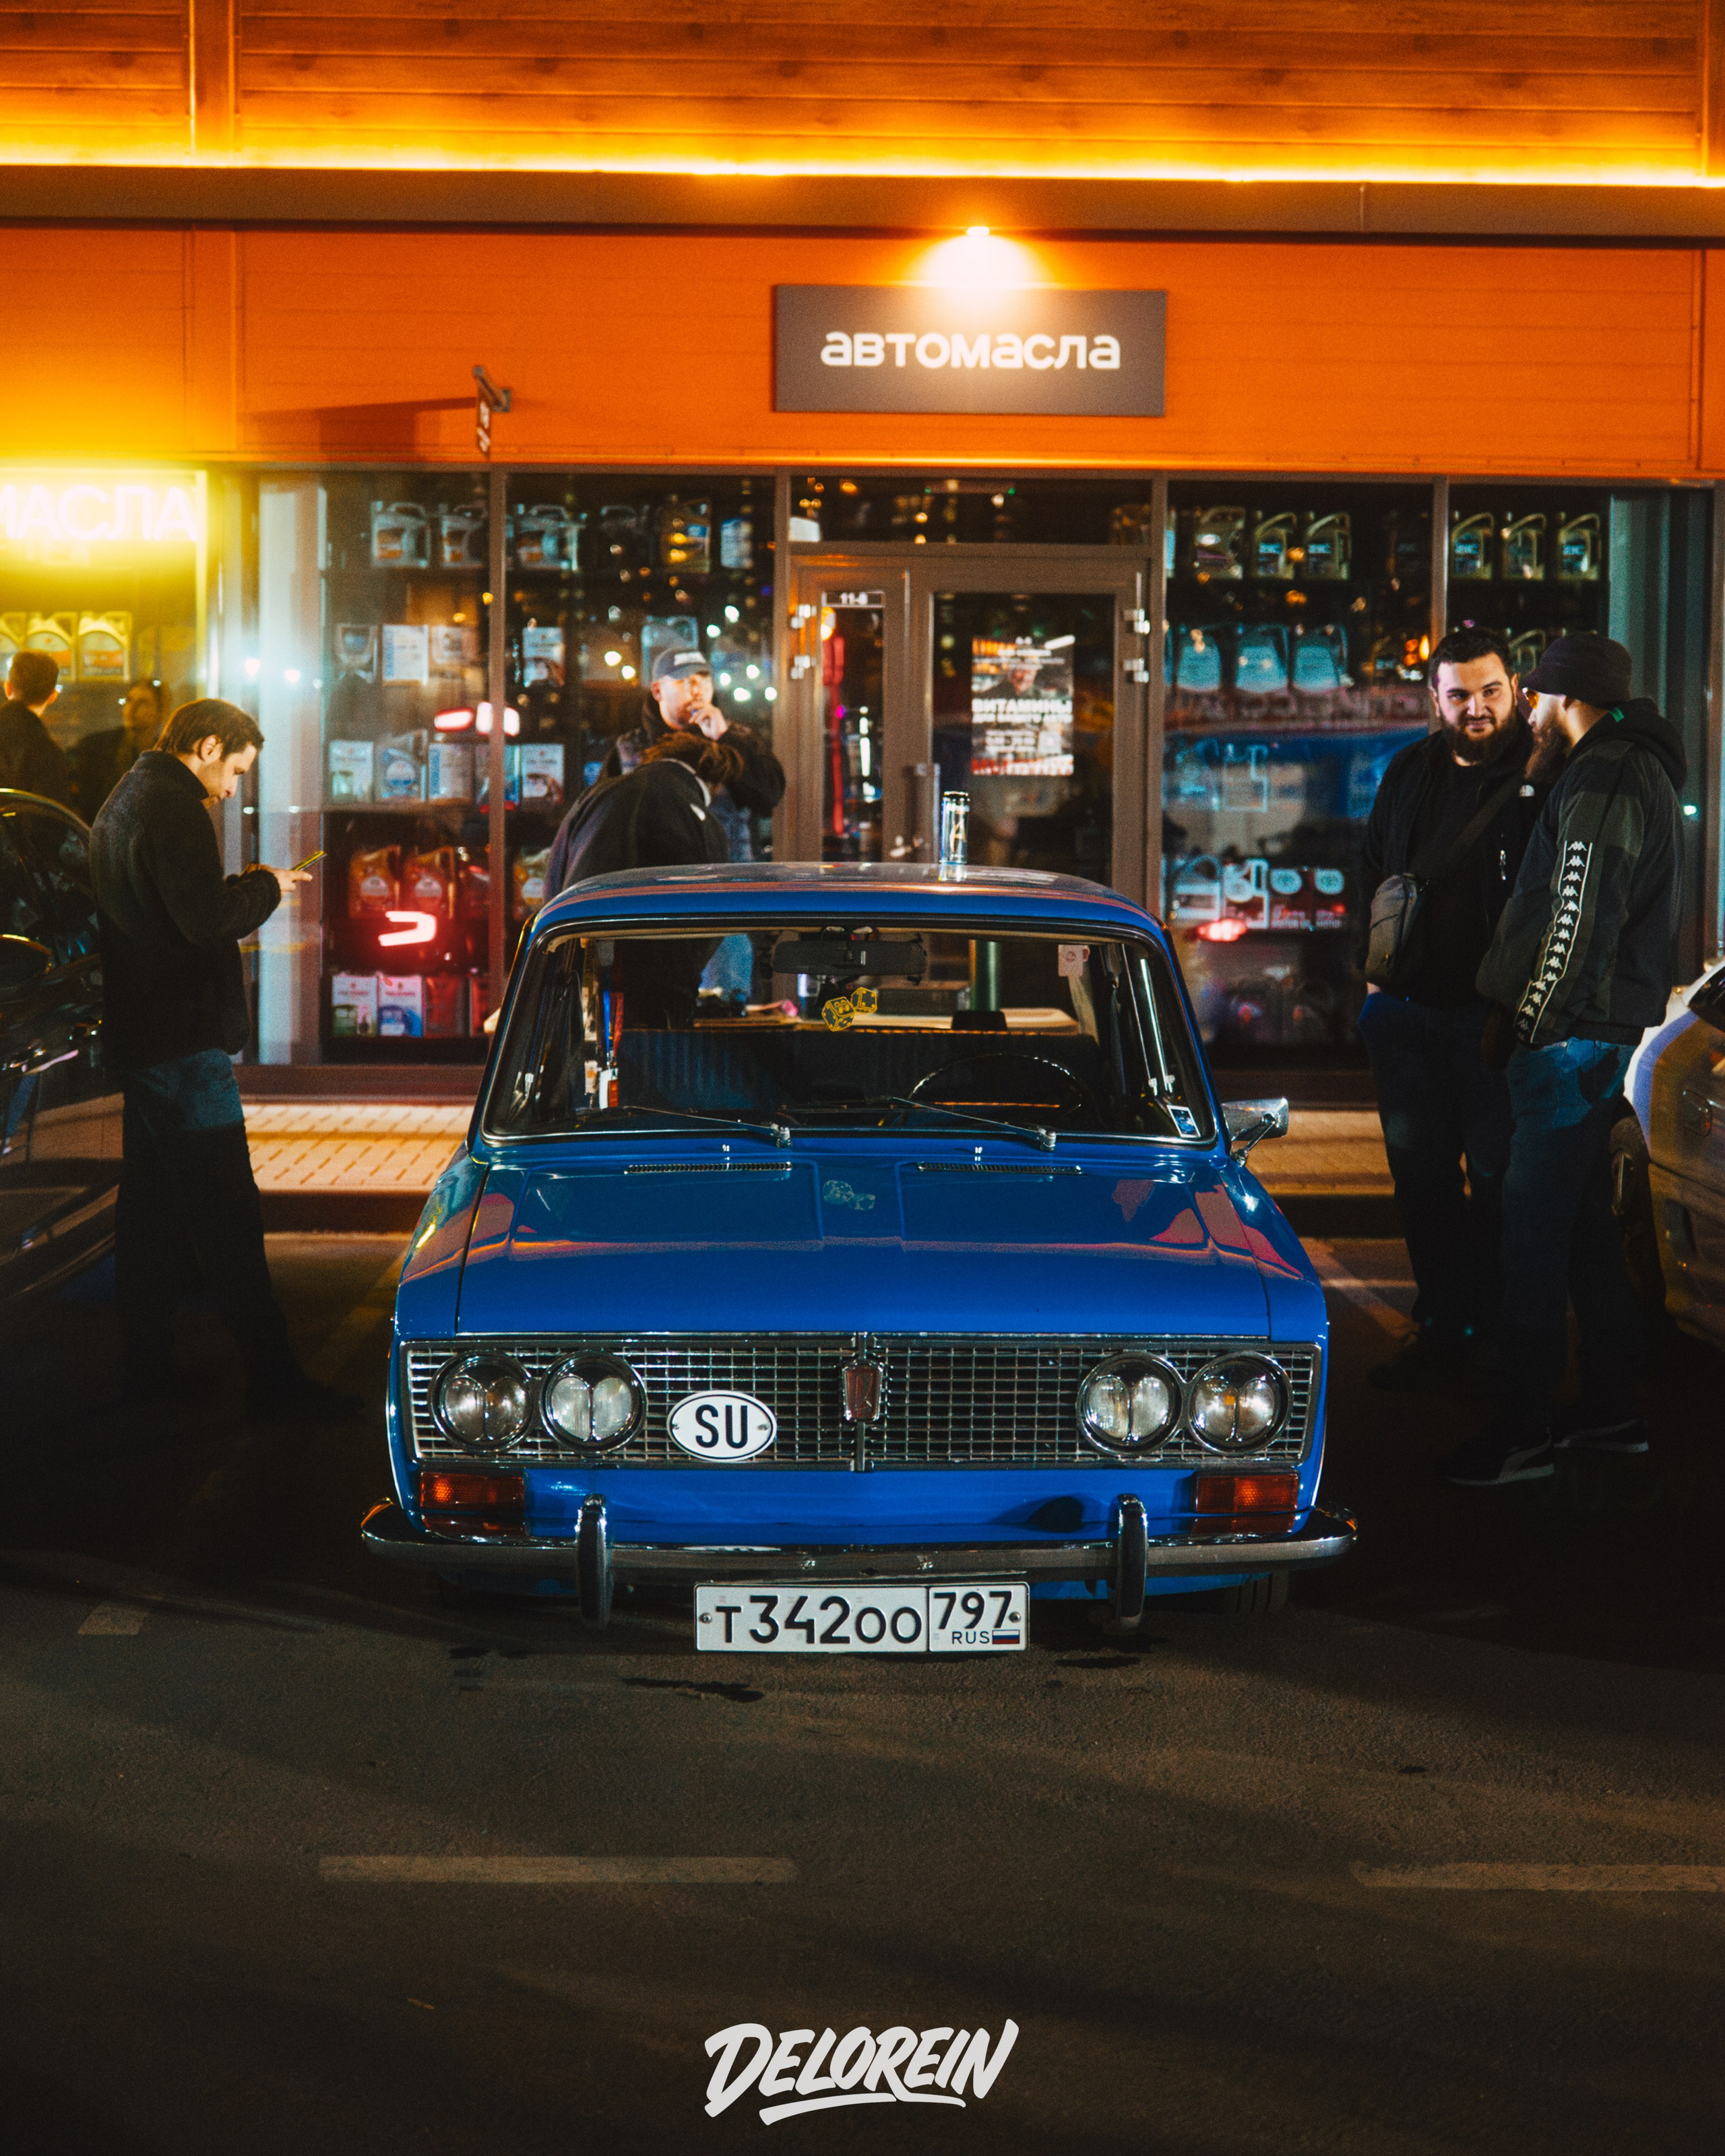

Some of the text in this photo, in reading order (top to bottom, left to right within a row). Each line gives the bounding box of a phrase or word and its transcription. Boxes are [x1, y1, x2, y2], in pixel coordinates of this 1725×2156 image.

[821, 331, 1121, 369] автомасла
[695, 1404, 748, 1449] SU
[934, 1591, 1012, 1630] 797
[951, 1630, 991, 1645] RUS
